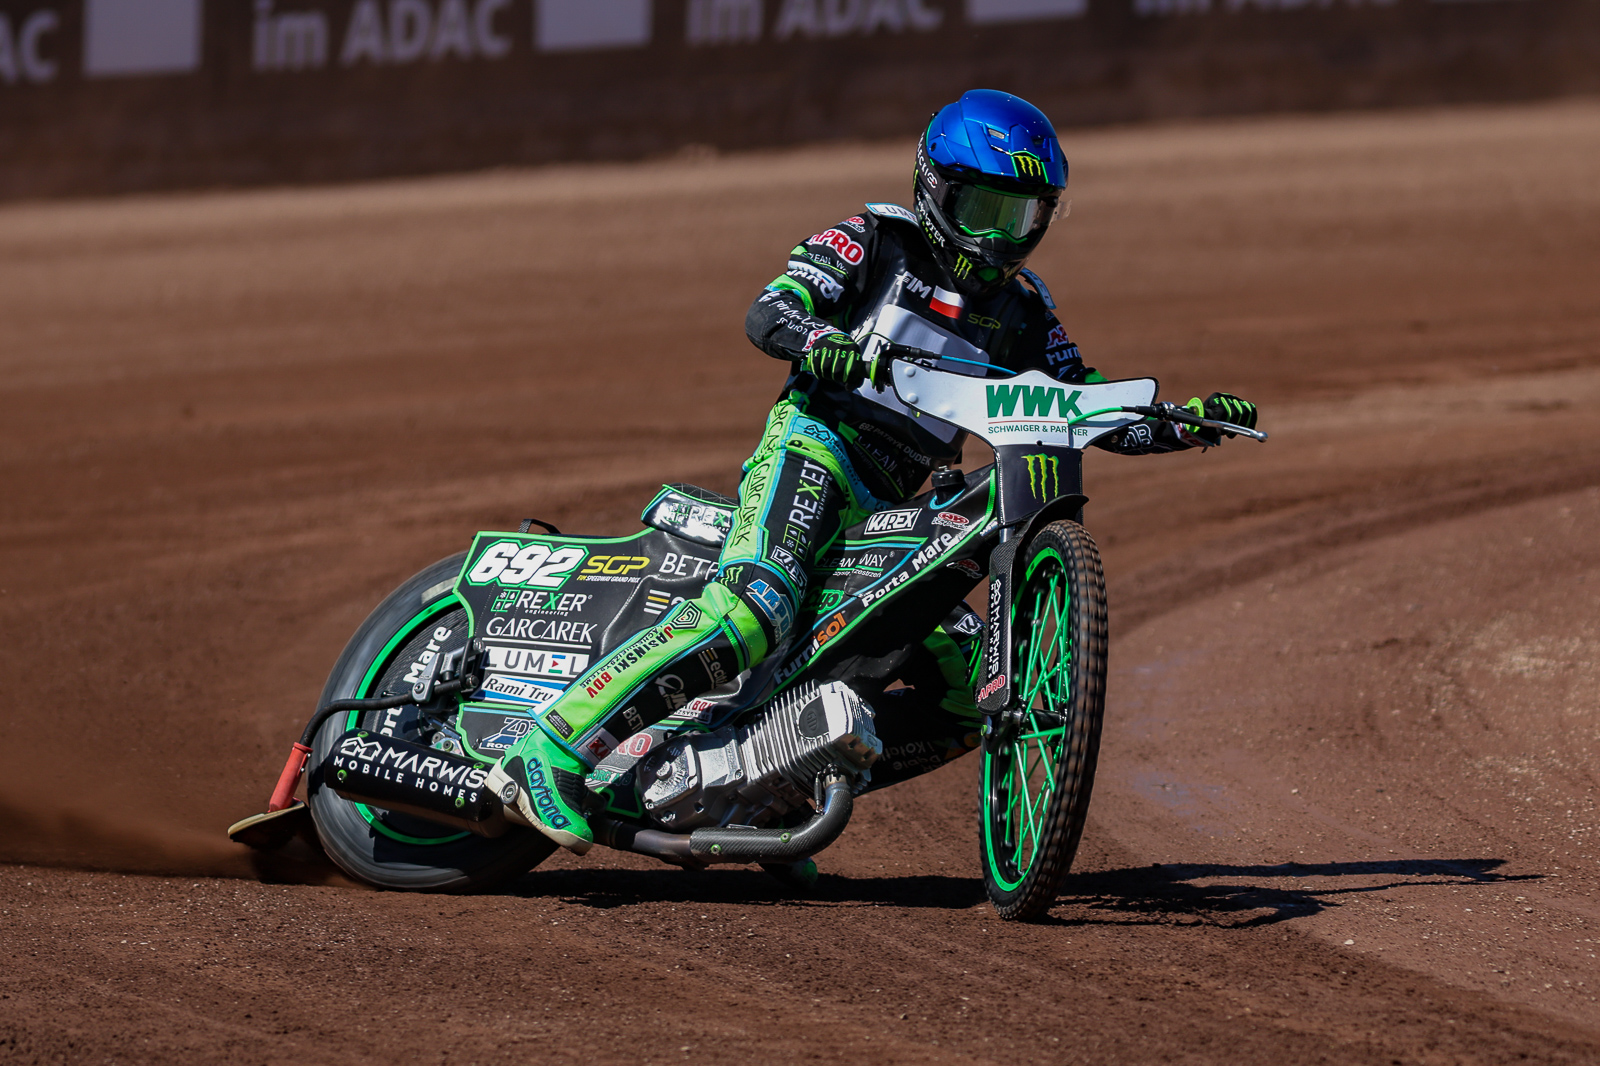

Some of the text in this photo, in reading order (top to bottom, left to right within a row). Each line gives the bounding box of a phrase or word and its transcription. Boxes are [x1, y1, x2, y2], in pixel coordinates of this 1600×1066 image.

[253, 0, 511, 71] im ADAC
[967, 312, 1001, 330] SGP
[985, 384, 1083, 419] WWK
[874, 428, 902, 450] PATRYK
[902, 444, 932, 466] DUDEK
[988, 424, 1088, 437] SCHWAIGER & PARTNER
[468, 541, 587, 588] 692
[580, 555, 651, 575] SGP
[858, 553, 888, 568] WAY
[861, 571, 910, 608] Porta
[911, 532, 954, 571] Mare
[517, 589, 588, 613] REXER
[524, 608, 569, 617] engineering
[486, 616, 598, 644] GARCAREK
[403, 626, 452, 684] Mare
[586, 625, 675, 699] JASINSKI BDV
[484, 676, 527, 697] Rami
[333, 756, 479, 803] MOBILE HOMES
[380, 747, 489, 790] MARWIS
[526, 756, 573, 830] daytona
